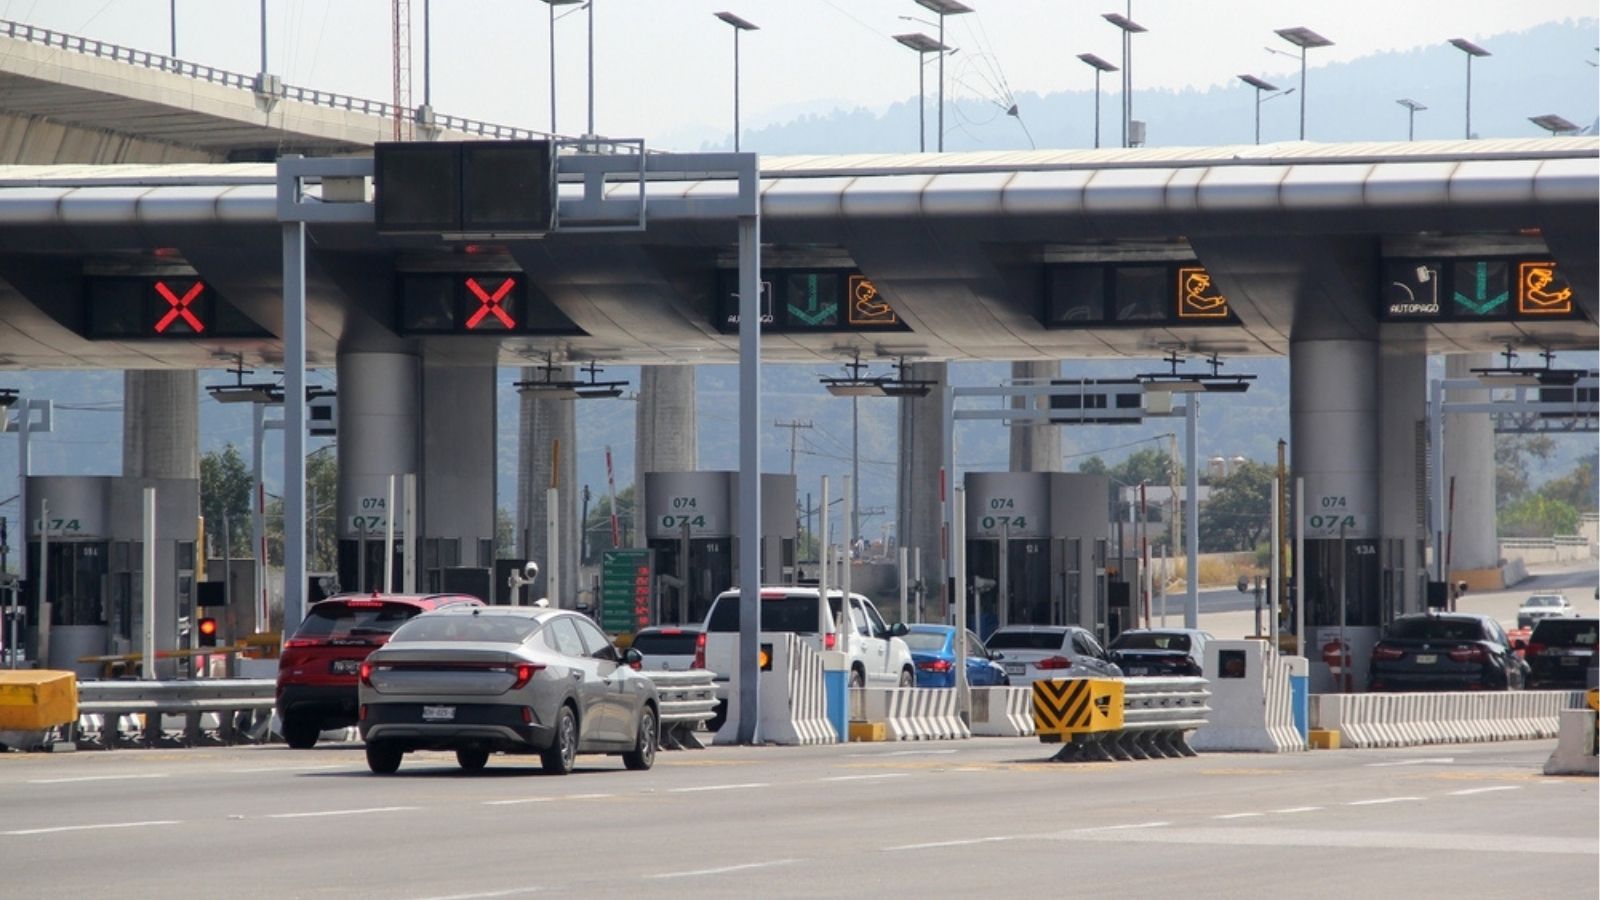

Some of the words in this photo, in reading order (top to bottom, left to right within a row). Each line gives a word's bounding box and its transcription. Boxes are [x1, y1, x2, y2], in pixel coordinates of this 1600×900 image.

[1390, 303, 1439, 313] AUTOPAGO
[362, 498, 386, 509] 074
[673, 497, 697, 508] 074
[991, 498, 1014, 509] 074
[1322, 496, 1346, 508] 074
[662, 515, 706, 528] 074
[1310, 515, 1356, 529] 074
[1355, 545, 1377, 555] 13A
